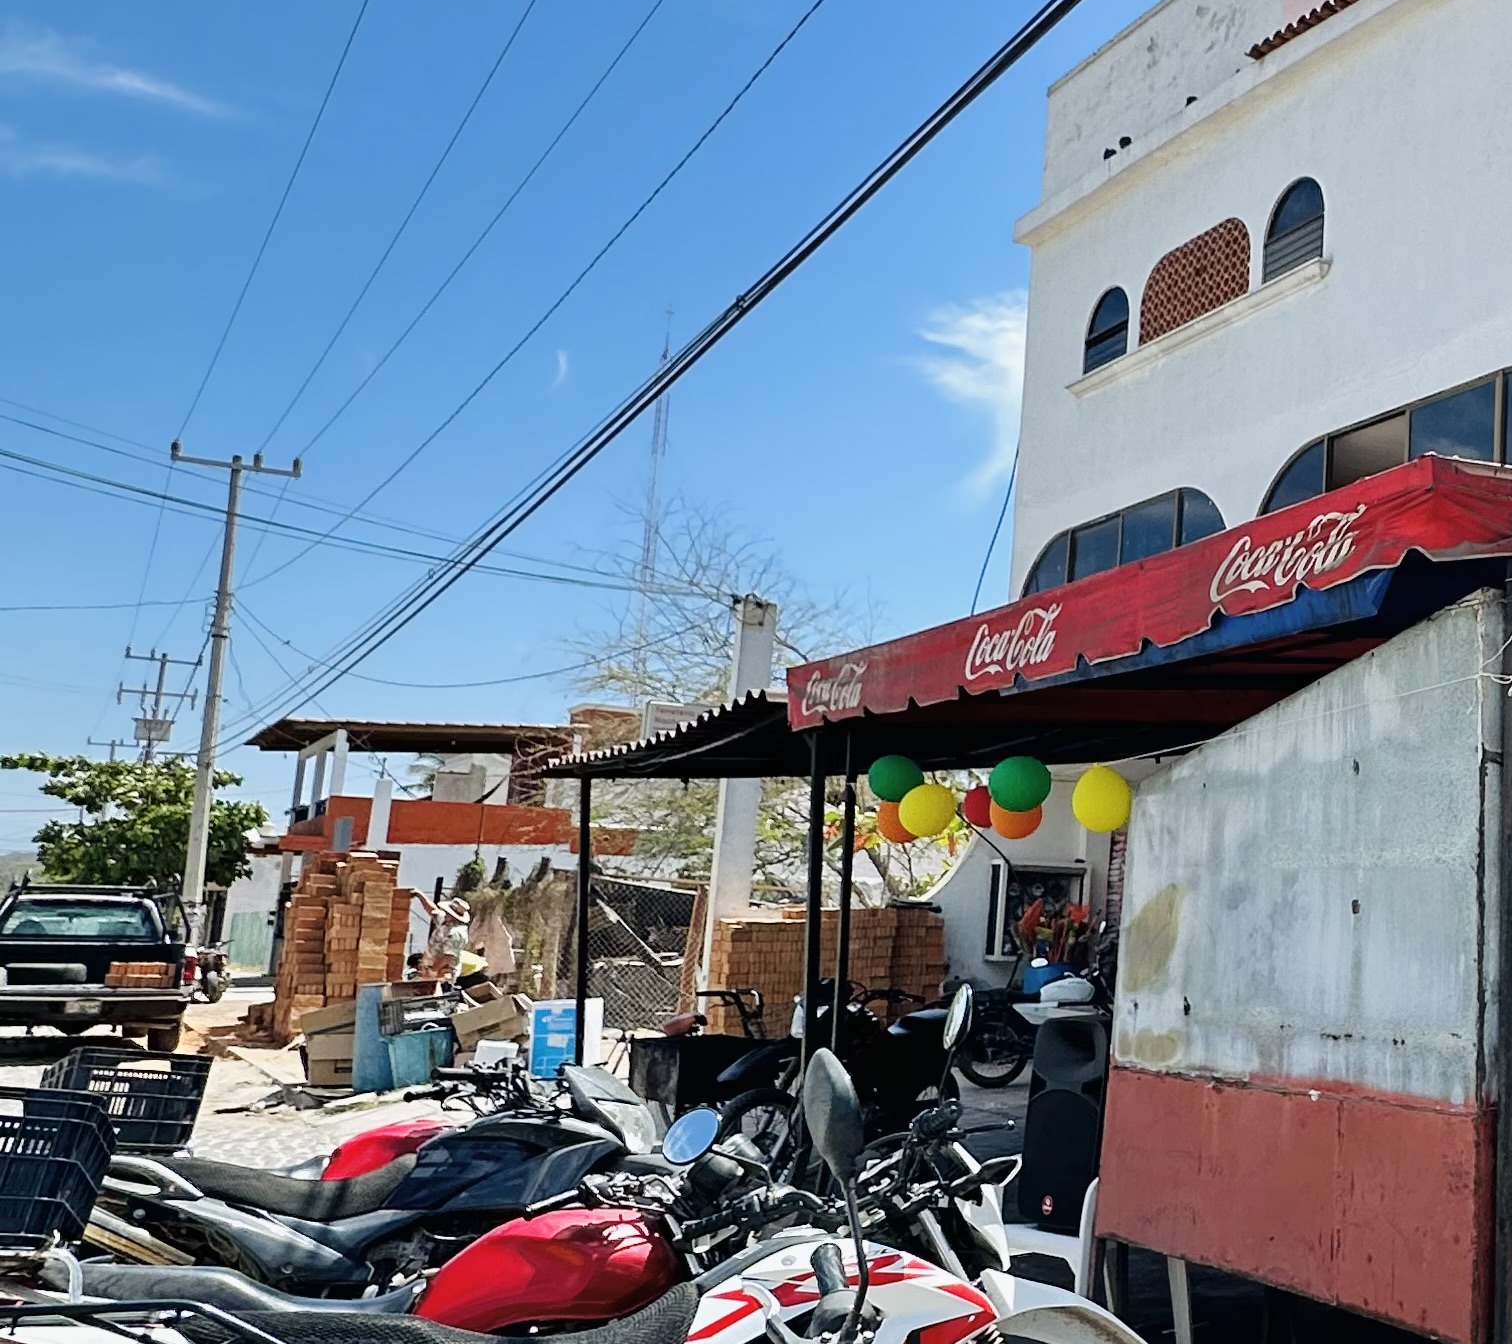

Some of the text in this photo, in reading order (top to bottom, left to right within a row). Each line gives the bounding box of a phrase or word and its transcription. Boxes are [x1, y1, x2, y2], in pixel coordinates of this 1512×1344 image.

[1210, 503, 1367, 602] Coca-Cola
[965, 602, 1063, 680] Coca-Cola
[802, 660, 868, 716] Coca-Cola
